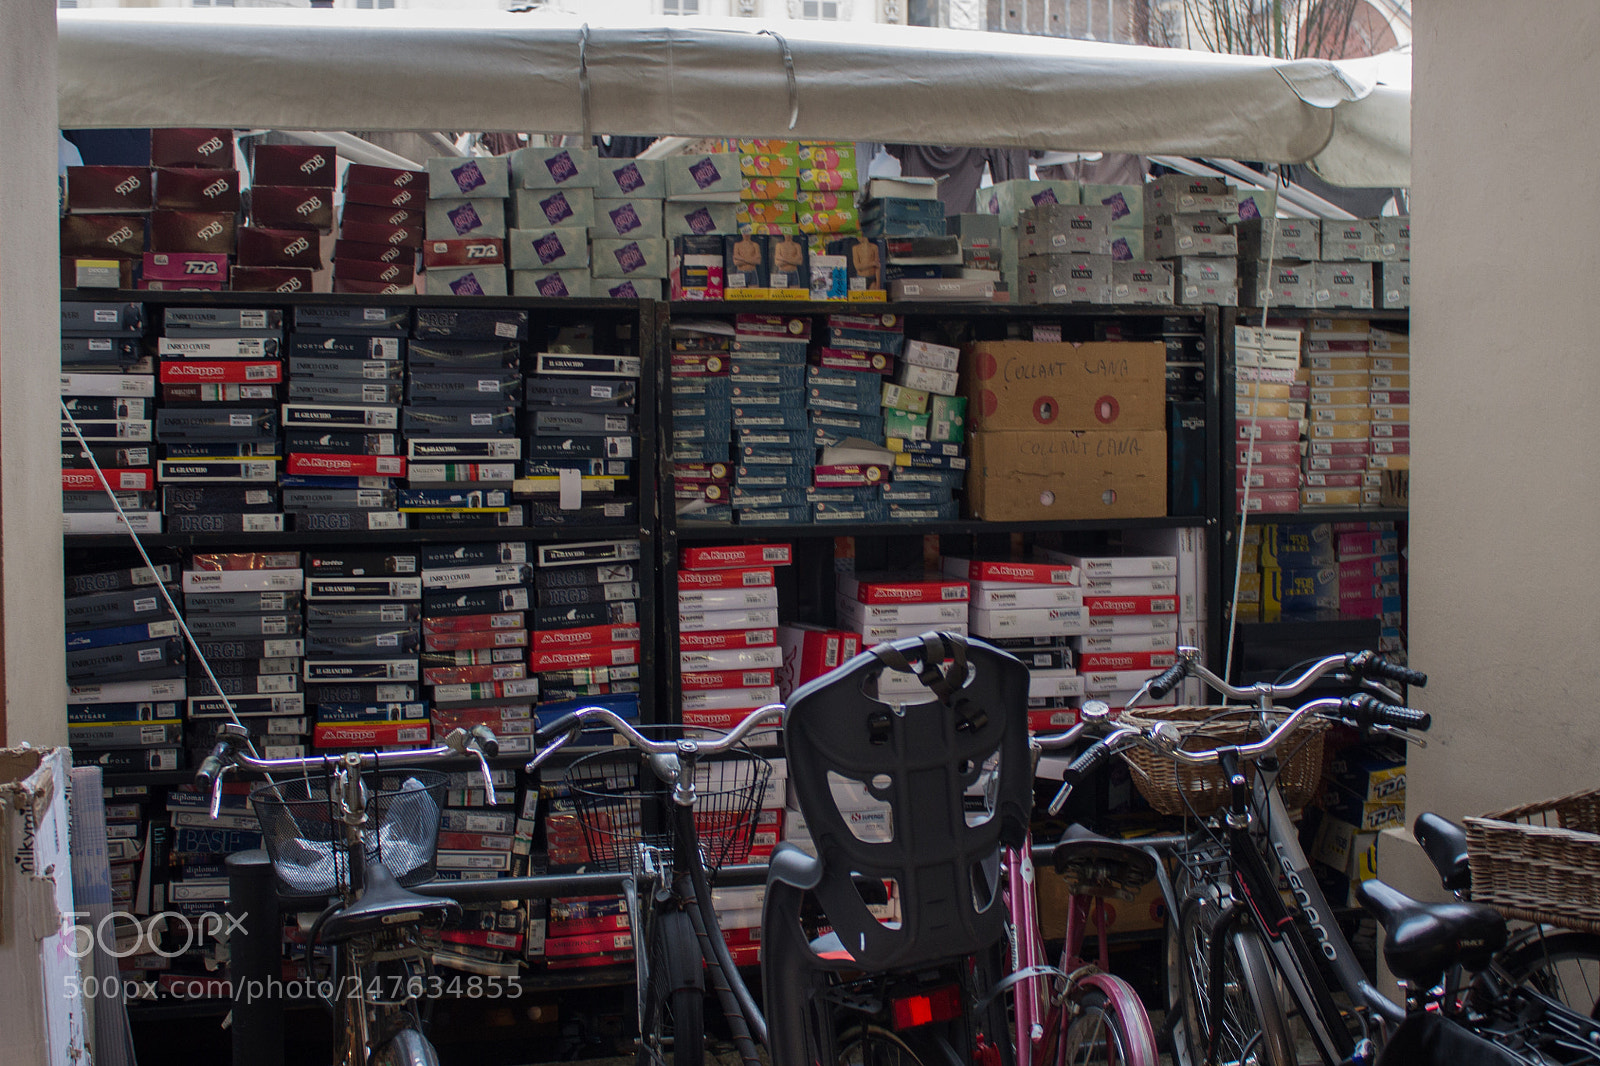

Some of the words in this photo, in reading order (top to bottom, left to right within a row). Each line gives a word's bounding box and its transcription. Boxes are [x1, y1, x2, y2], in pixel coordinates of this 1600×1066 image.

[182, 366, 225, 377] Kappa
[1003, 357, 1067, 384] COLLANT
[1020, 439, 1087, 456] COLLANT
[311, 458, 351, 468] Kappa
[62, 474, 94, 483] appa
[179, 515, 224, 531] IRGE
[308, 513, 351, 529] IRGE
[428, 553, 454, 561] NORTH
[711, 551, 745, 561] Kappa
[1000, 567, 1034, 577] Kappa
[686, 574, 722, 583] Kappa
[889, 590, 922, 599] Kappa
[1100, 602, 1136, 610] Kappa
[555, 632, 591, 642] Kappa
[688, 635, 725, 644] Kappa
[553, 653, 590, 663] Kappa
[1100, 657, 1133, 665] Kappa
[686, 674, 723, 684] Kappa
[694, 713, 730, 722] Kappa
[336, 731, 376, 740] Kappa
[171, 793, 205, 802] diplomat
[186, 865, 219, 875] diplomat
[182, 902, 215, 911] diplomat
